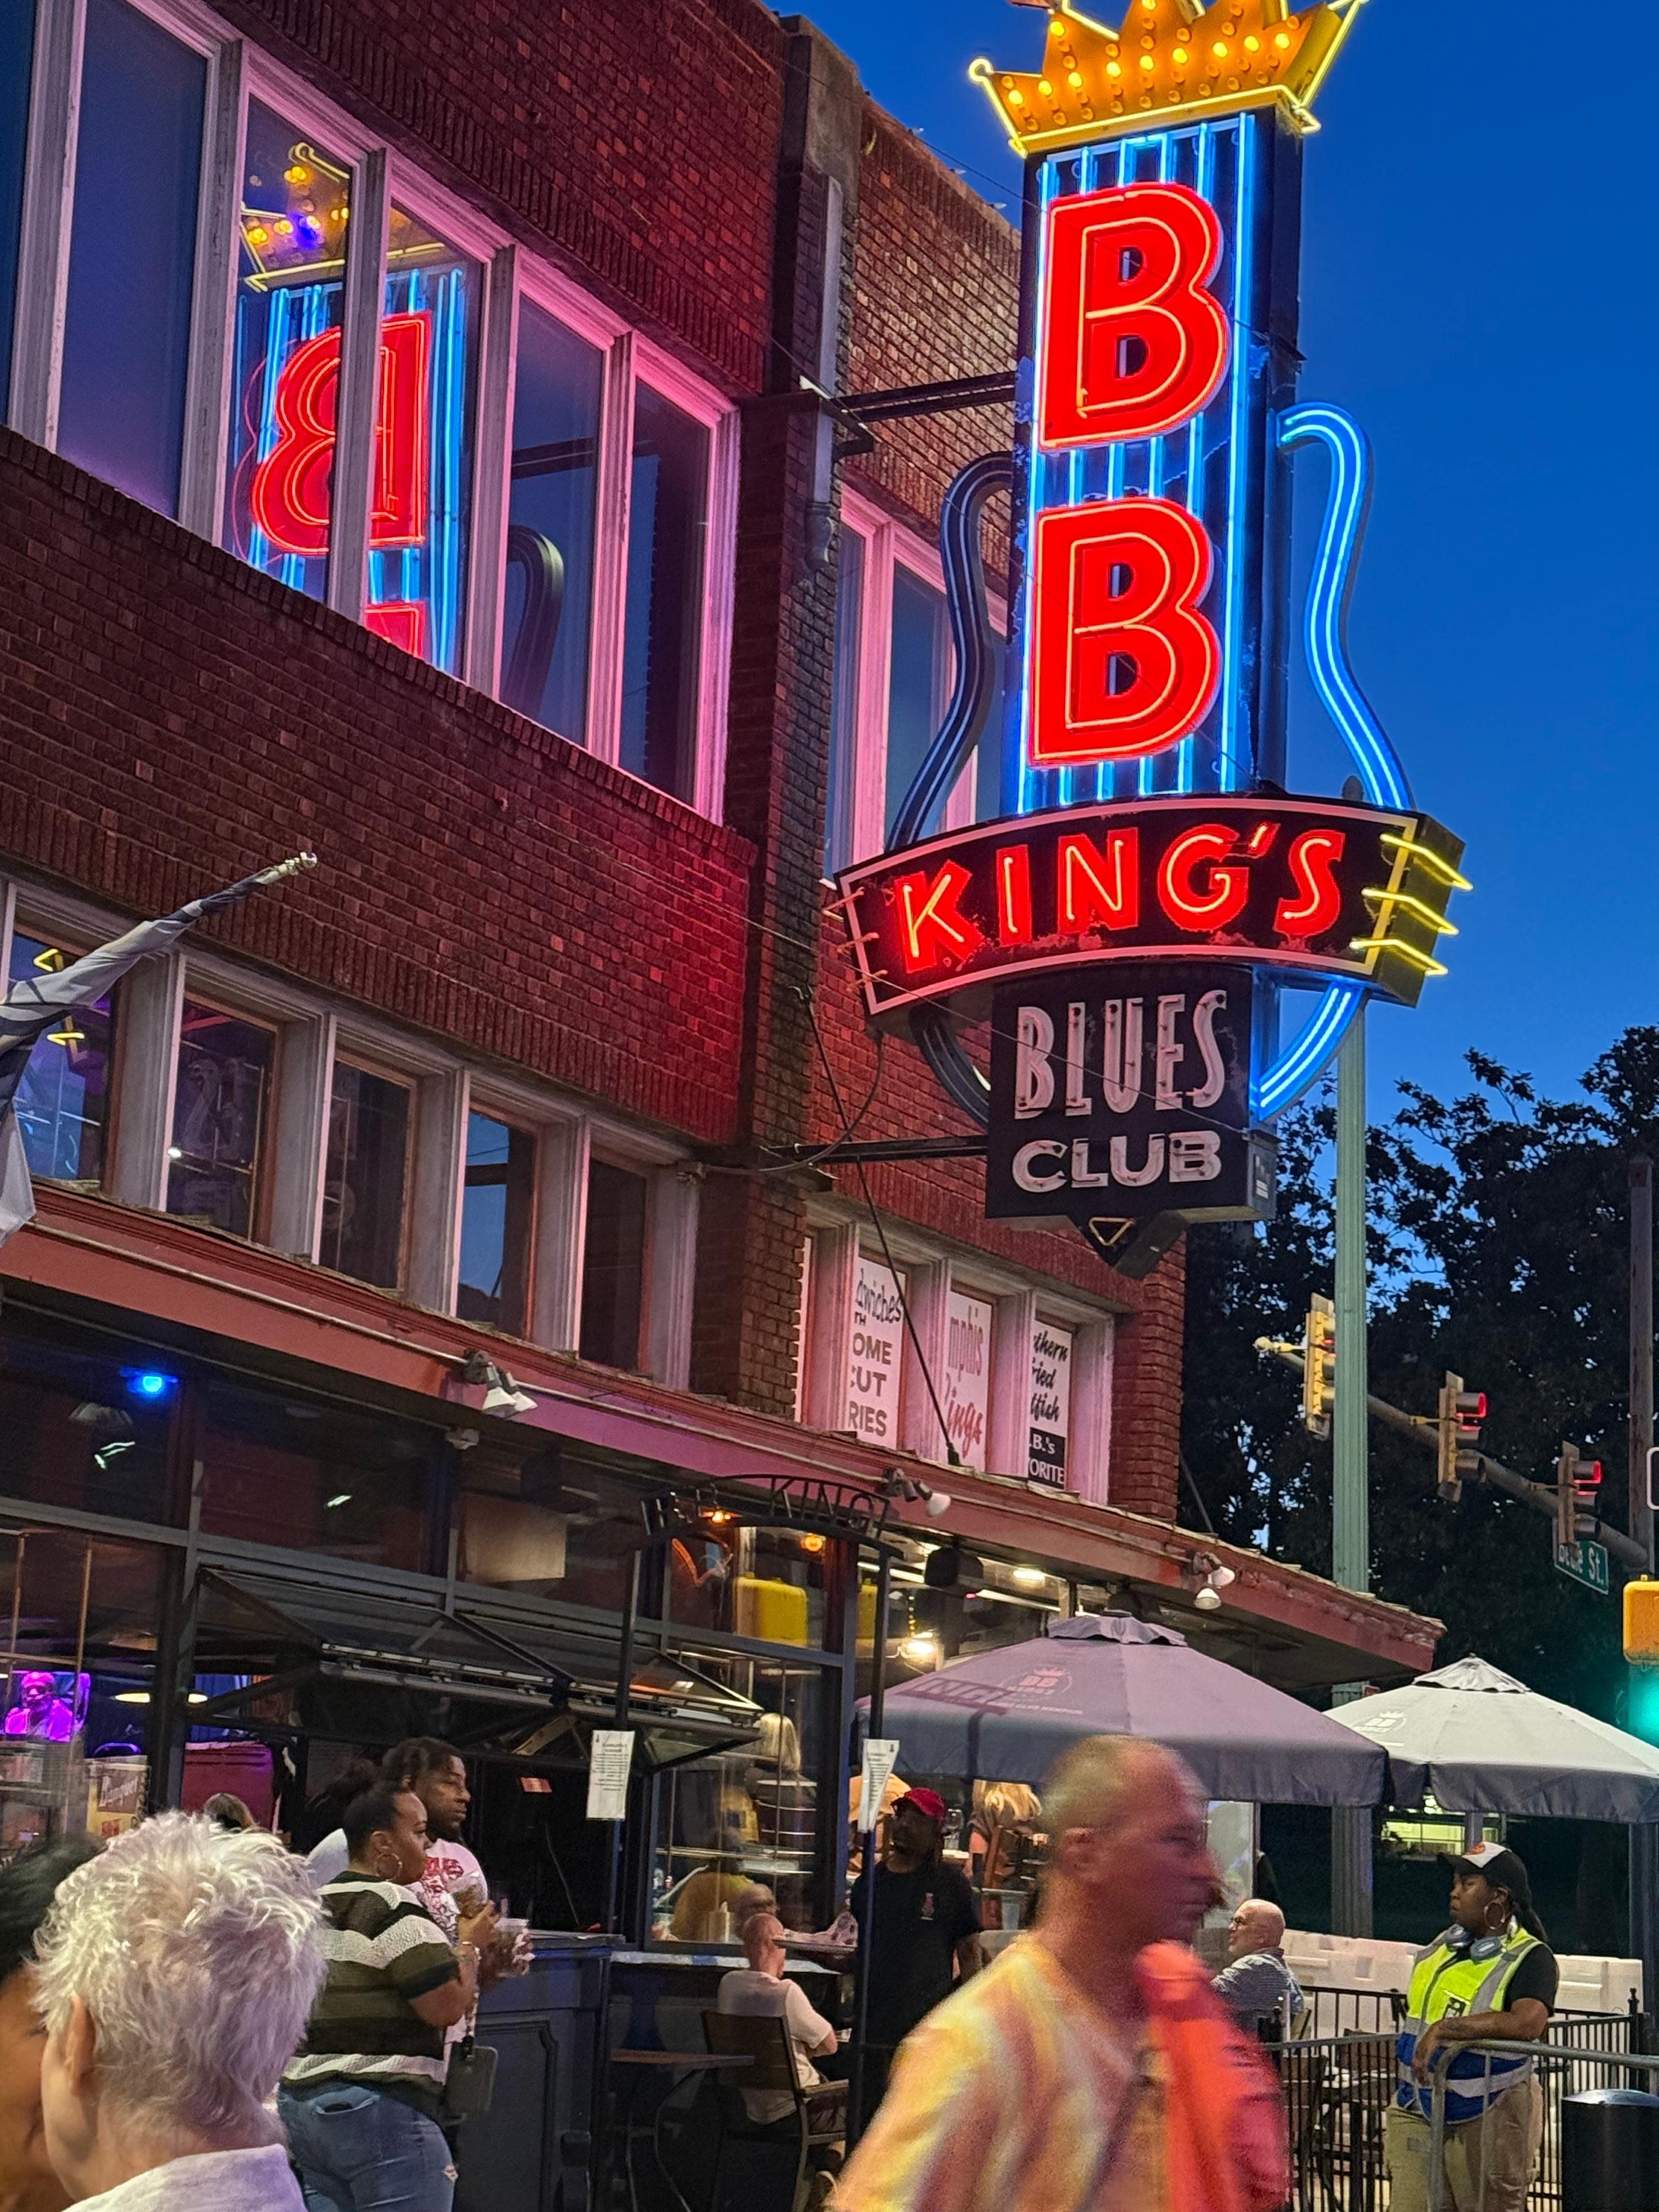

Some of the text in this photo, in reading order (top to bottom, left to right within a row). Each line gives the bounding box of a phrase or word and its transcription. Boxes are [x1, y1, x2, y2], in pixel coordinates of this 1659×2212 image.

[1039, 182, 1231, 450] B
[1029, 497, 1222, 768] B
[894, 822, 1347, 974] KING'S
[1013, 989, 1227, 1120] BLUES
[1012, 1129, 1221, 1193] CLUB
[850, 1365, 887, 1397] UT
[853, 1332, 893, 1365] OME
[1033, 1330, 1069, 1362] thern
[848, 1400, 887, 1437] RIES
[945, 1372, 983, 1459] ings
